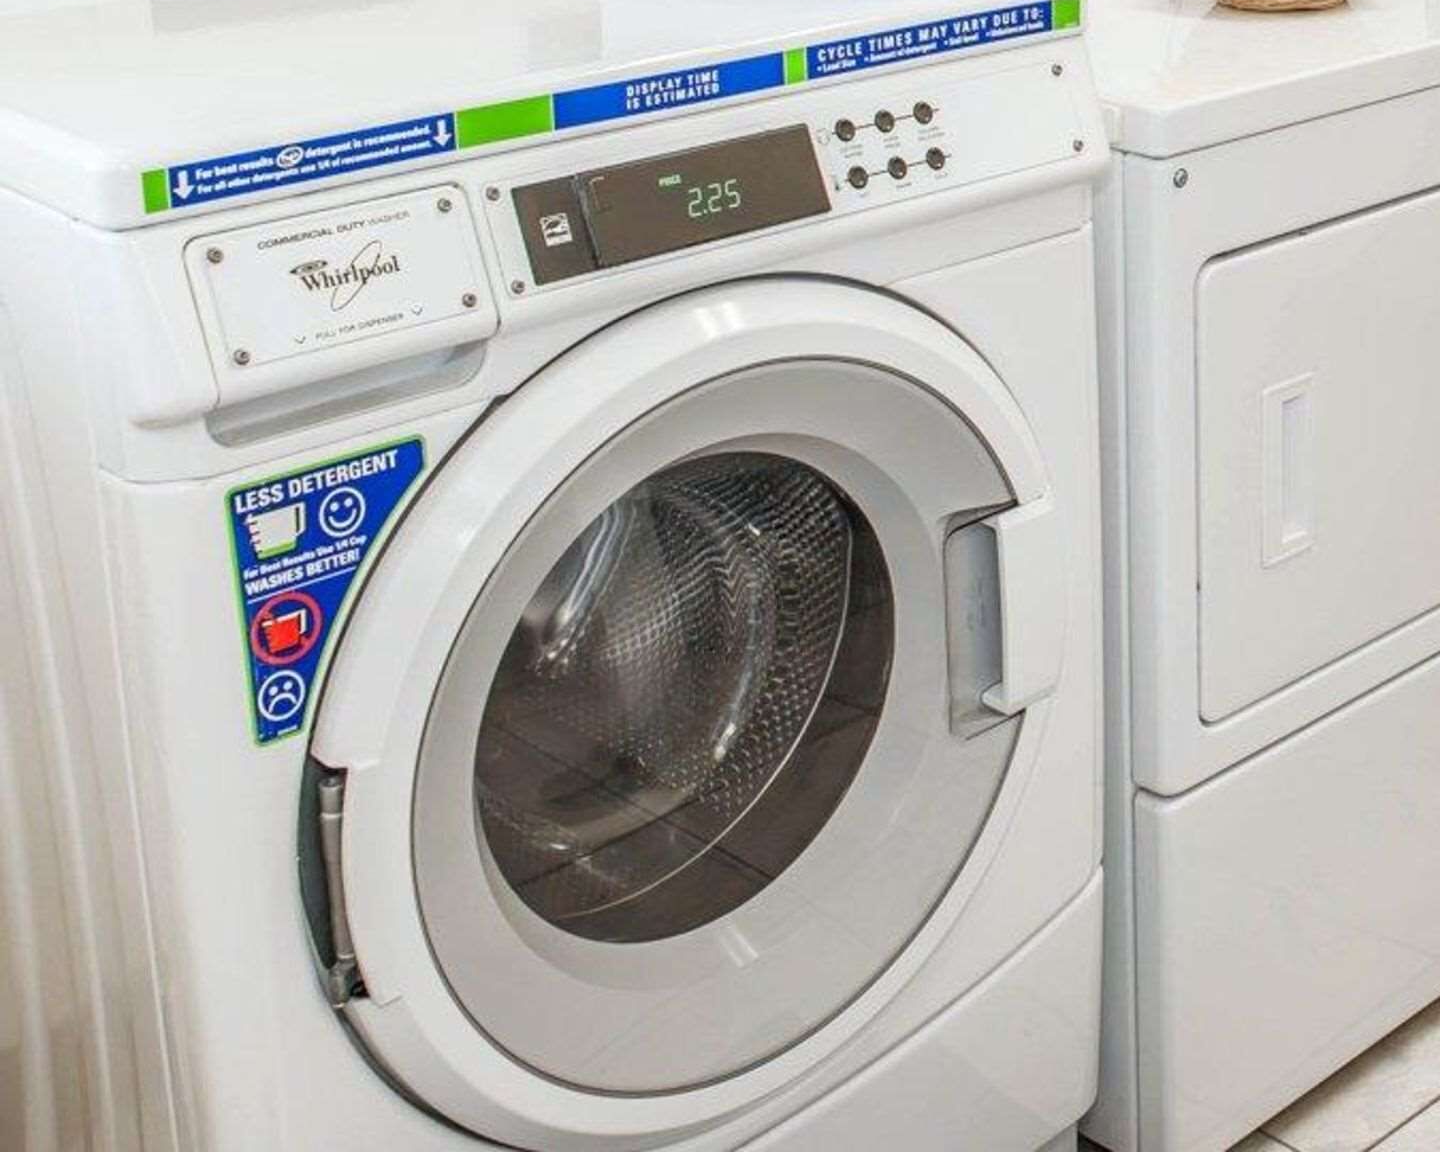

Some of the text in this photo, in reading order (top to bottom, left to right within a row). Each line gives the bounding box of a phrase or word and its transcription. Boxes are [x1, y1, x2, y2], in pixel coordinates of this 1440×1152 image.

[817, 41, 863, 62] CYCLE
[868, 32, 912, 52] TIMES
[918, 24, 948, 43] MAY
[952, 16, 988, 35] VARY
[992, 10, 1018, 27] DUE
[1024, 6, 1045, 21] TO:
[626, 69, 720, 97] DISPLAY TIME
[626, 82, 721, 110] IS ESTIMATED
[195, 168, 214, 180] For
[214, 163, 238, 176] best
[239, 156, 274, 171] results
[305, 141, 352, 159] detergent
[353, 138, 363, 150] is
[197, 184, 213, 195] For
[688, 178, 742, 218] 2.25
[257, 210, 411, 251] COMMERCIAL DUTY WASHER
[300, 254, 401, 292] Whirlpool
[235, 449, 398, 513] LESS DETERGENT
[243, 568, 260, 580] For
[260, 560, 282, 575] Best
[282, 550, 316, 568] Results
[316, 544, 335, 558] Use
[349, 534, 368, 548] Cup
[245, 548, 361, 596] WASHES BETTER!
